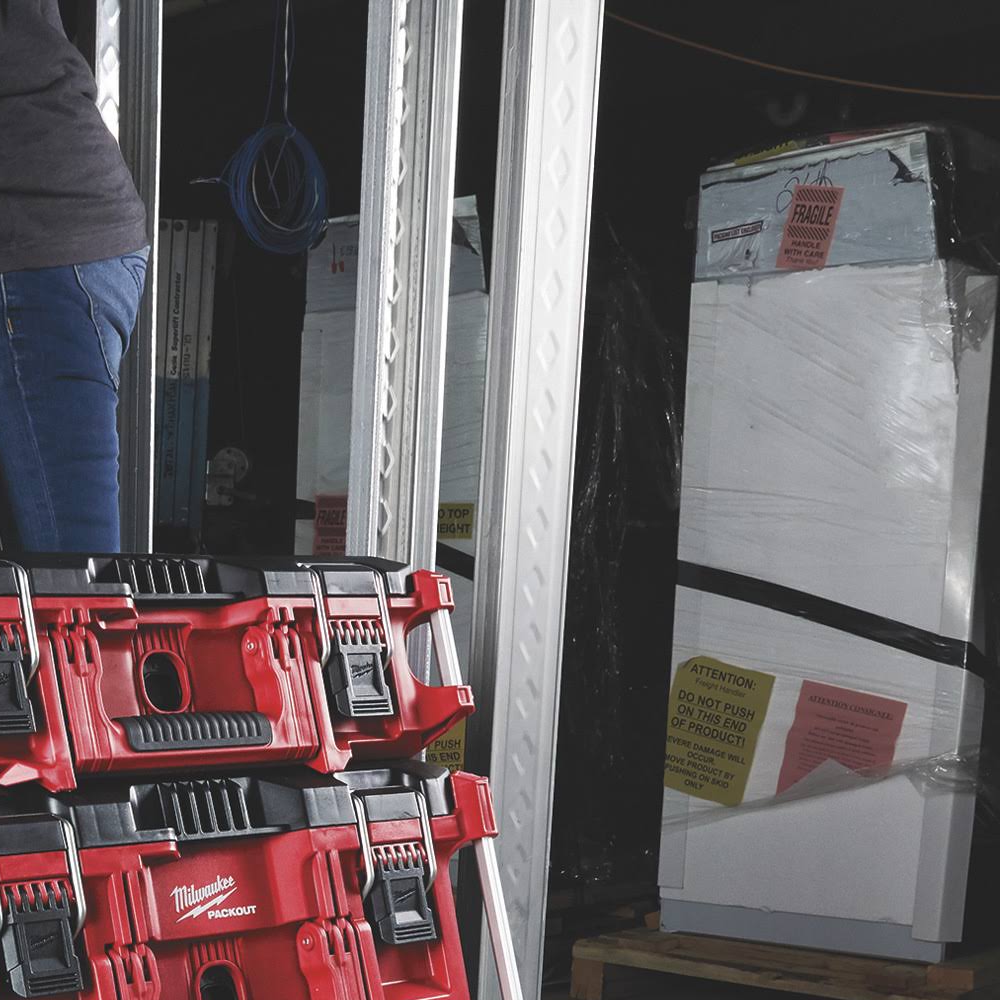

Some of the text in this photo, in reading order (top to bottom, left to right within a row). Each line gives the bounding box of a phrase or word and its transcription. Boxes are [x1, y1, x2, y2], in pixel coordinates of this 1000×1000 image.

[792, 204, 834, 226] FRAGILE
[784, 249, 825, 260] WITH CARE
[792, 240, 822, 250] HANDLE
[172, 272, 182, 314] Contractor
[171, 316, 179, 352] Superlift
[449, 509, 470, 518] TOP
[690, 664, 757, 690] ATTENTION:
[678, 688, 756, 720] DO NOT PUSH
[677, 704, 747, 733] ON THIS END
[671, 717, 746, 748] OF PRODUCT!
[434, 739, 462, 750] PUSH
[440, 752, 460, 762] END
[693, 743, 726, 759] DAMAGE
[727, 753, 746, 766] WILL
[686, 760, 723, 777] PRODUCT
[684, 778, 704, 791] ONLY
[698, 774, 711, 784] ON
[170, 875, 236, 913] Milwaukee
[207, 905, 256, 920] PACKOUT
